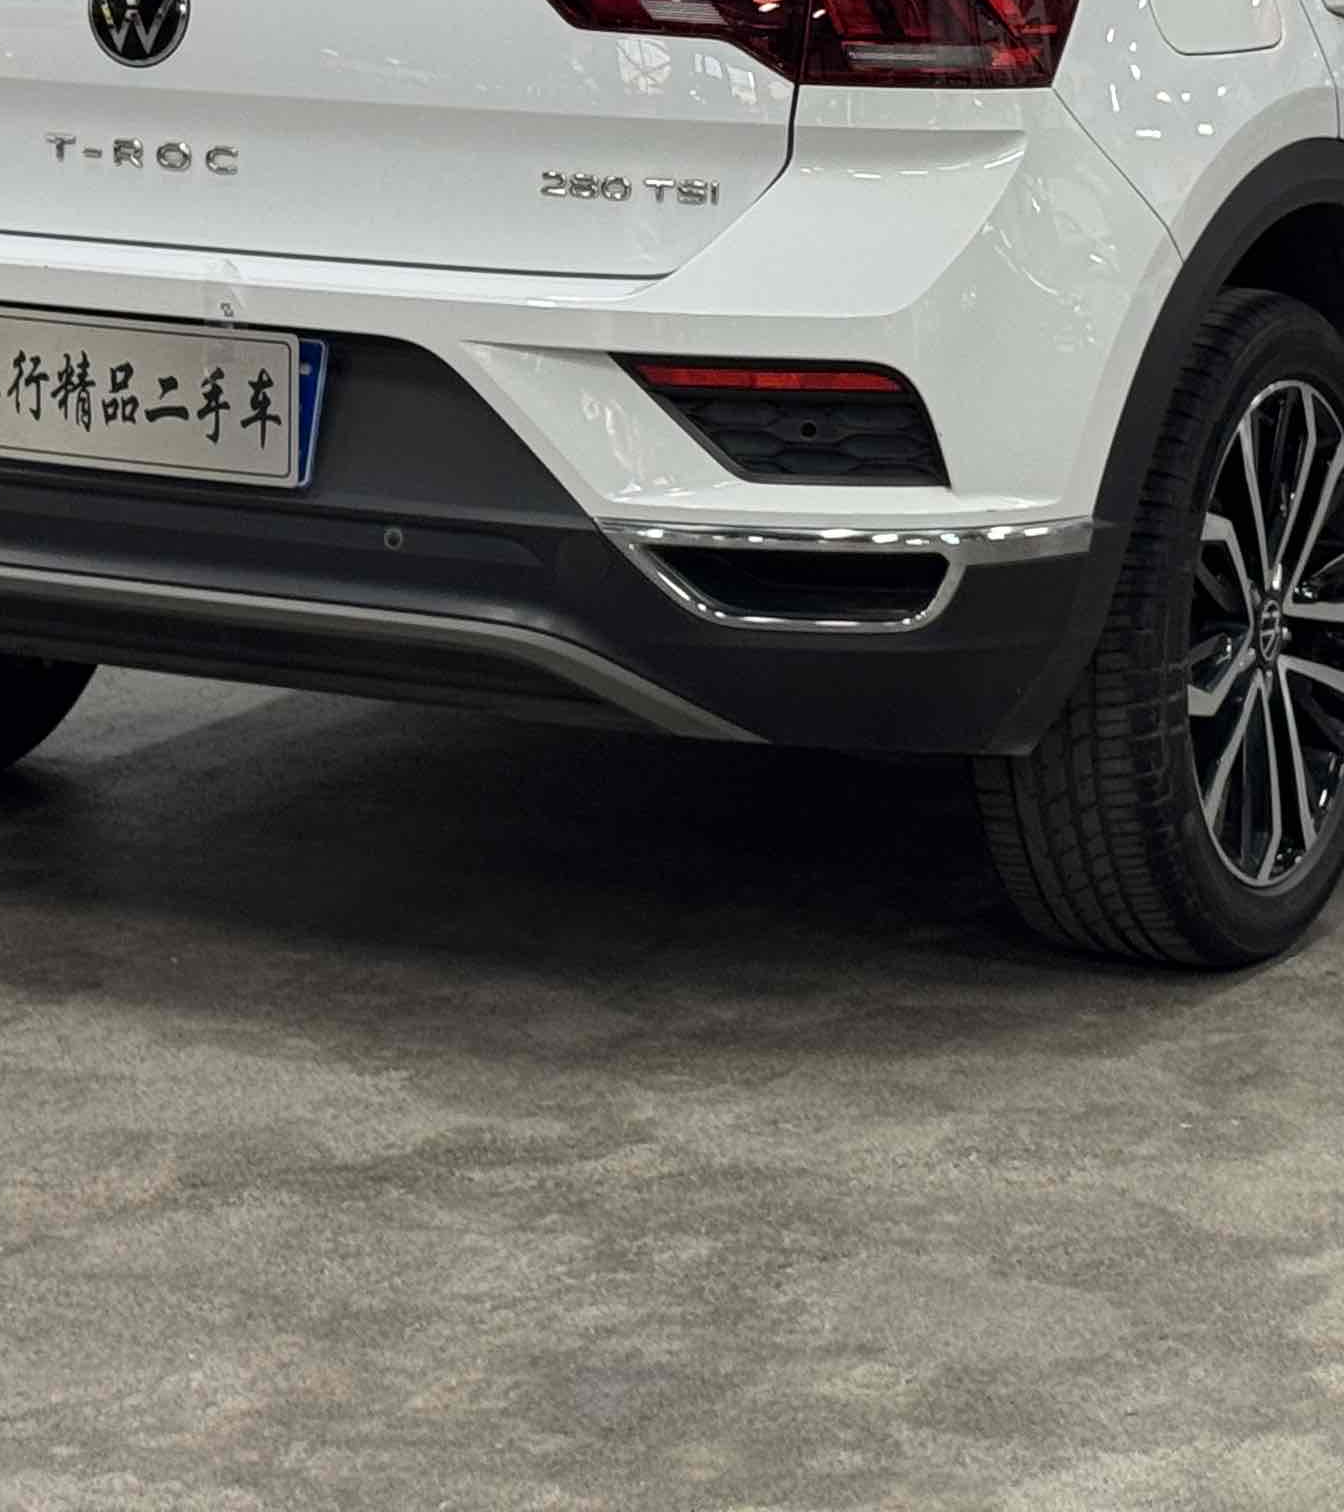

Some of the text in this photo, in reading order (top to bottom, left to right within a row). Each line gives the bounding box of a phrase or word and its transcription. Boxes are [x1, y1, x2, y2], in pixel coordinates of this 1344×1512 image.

[46, 134, 239, 176] T-ROC
[541, 170, 720, 205] 280 TSI
